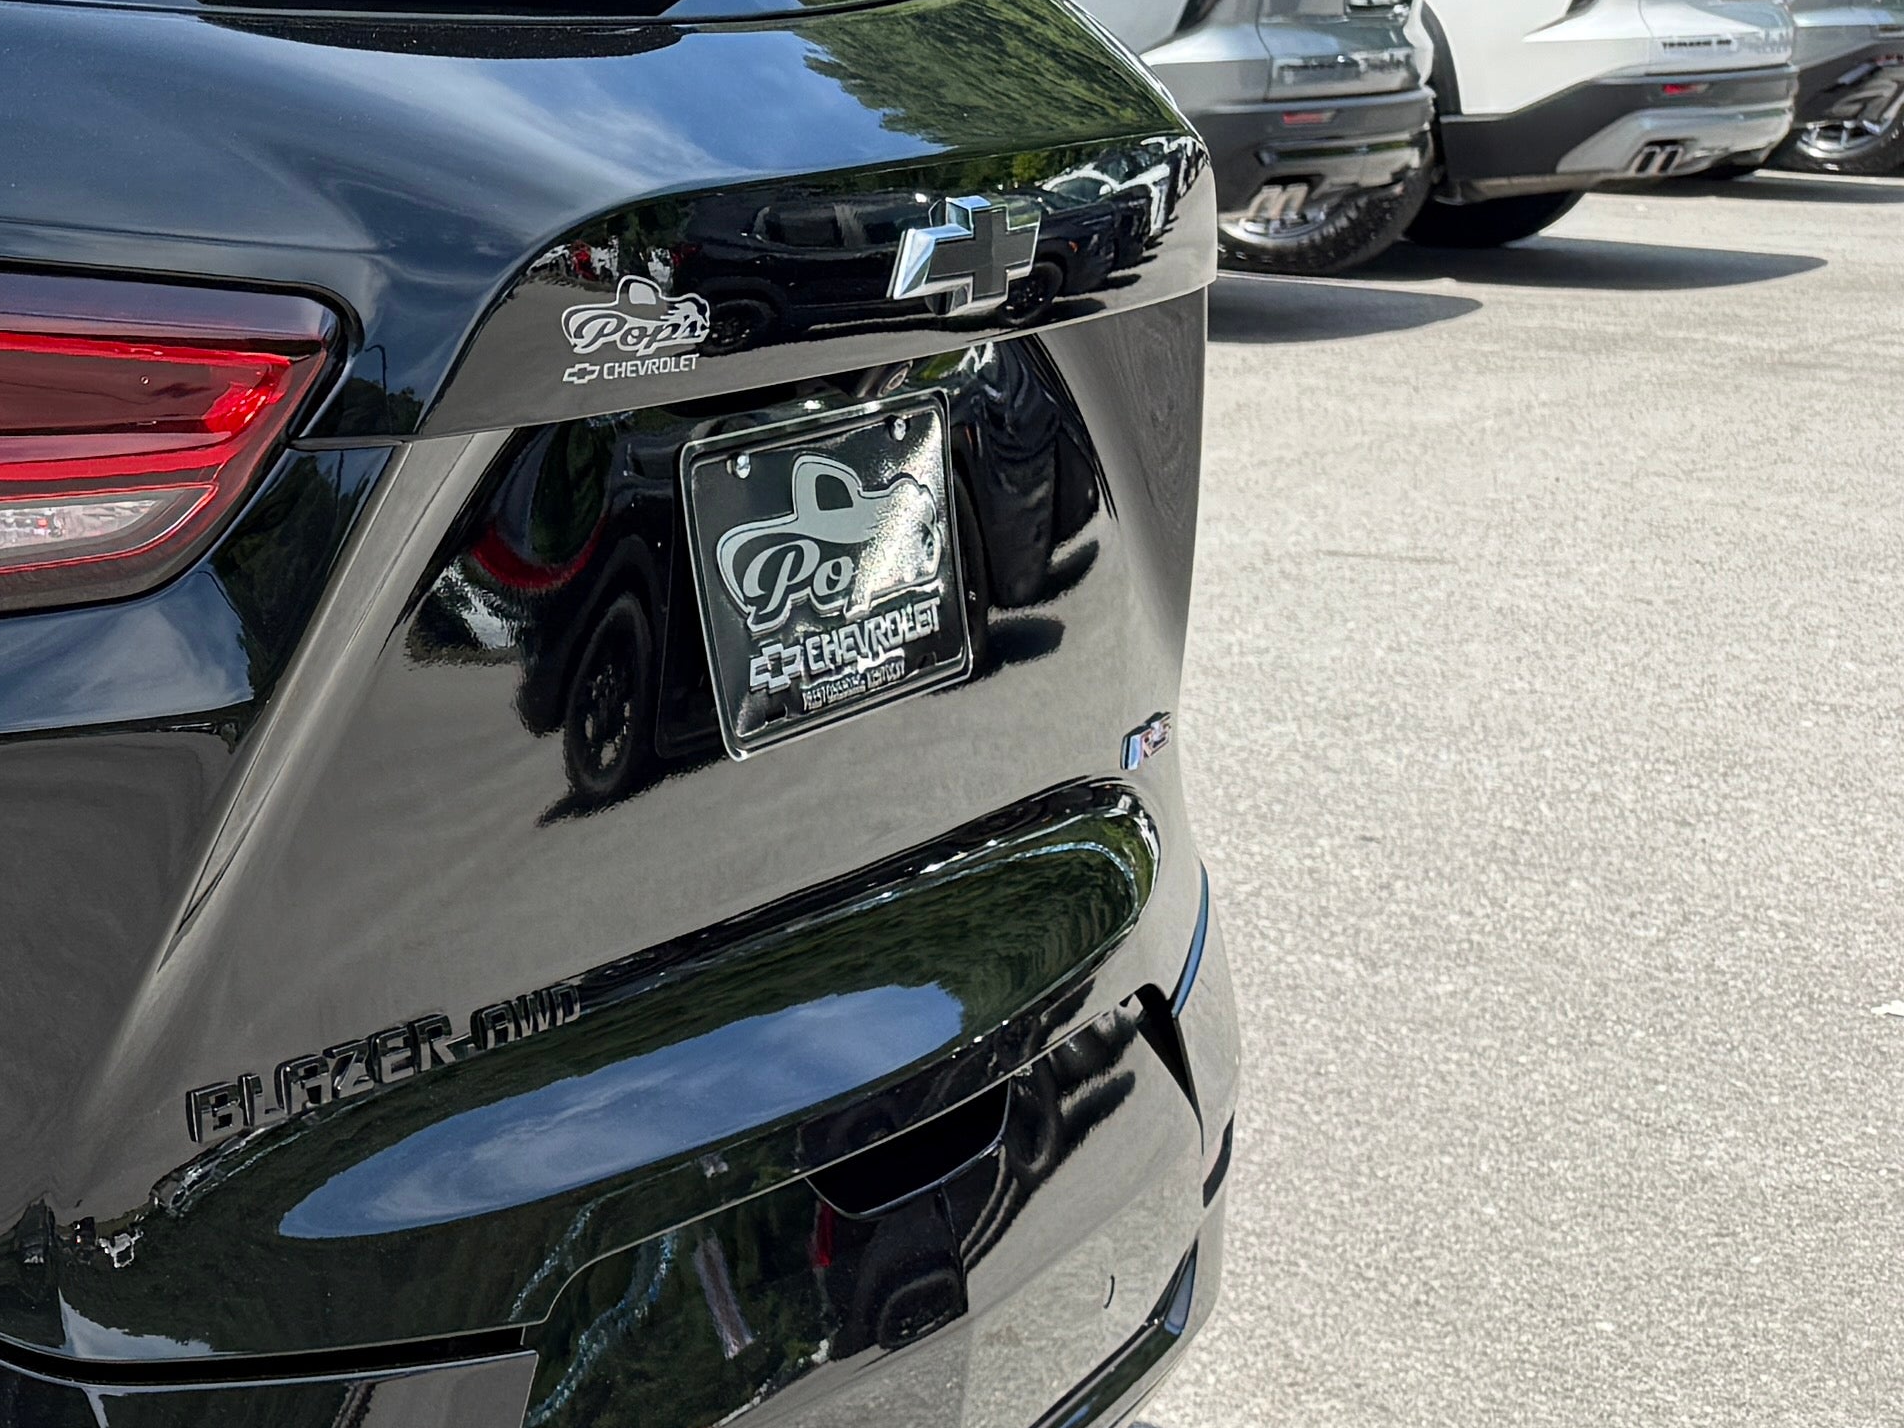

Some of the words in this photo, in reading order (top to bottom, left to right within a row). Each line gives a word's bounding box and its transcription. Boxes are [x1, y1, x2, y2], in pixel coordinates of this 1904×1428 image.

[603, 353, 700, 380] CHEVROLET
[805, 596, 941, 676] CHEVROLET
[186, 1012, 458, 1143] BLAZER
[470, 984, 582, 1052] AWD
